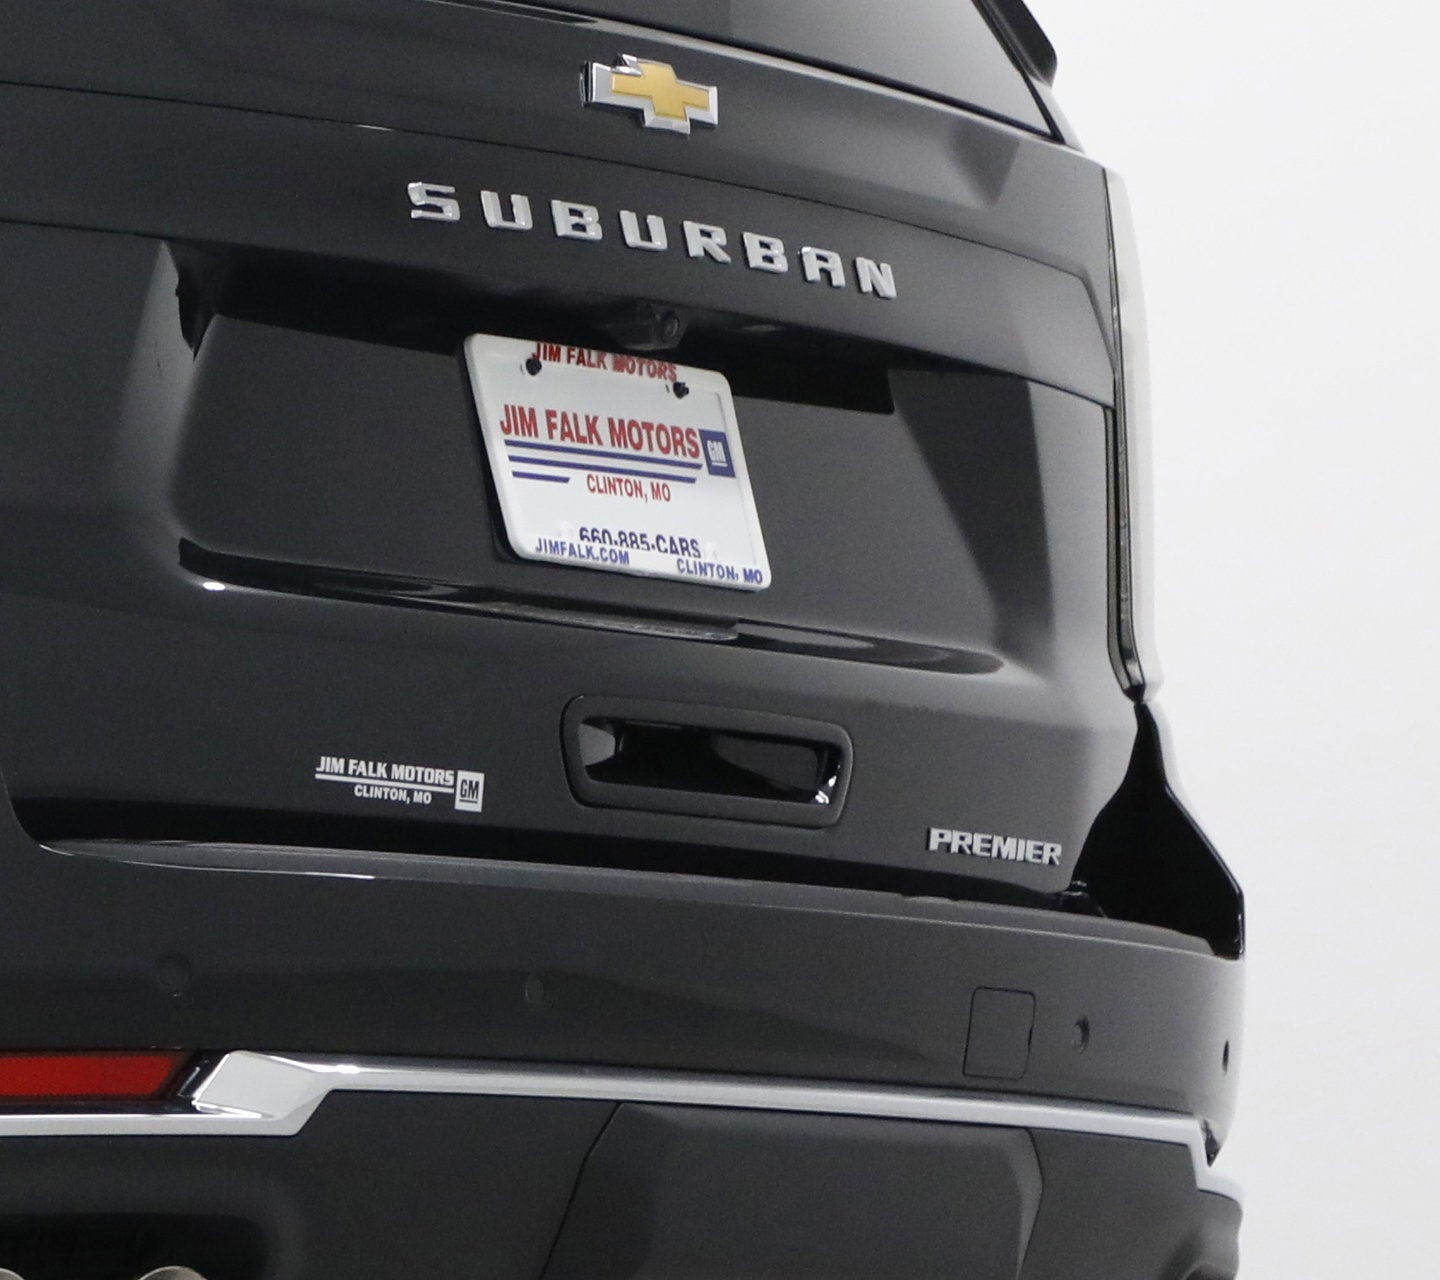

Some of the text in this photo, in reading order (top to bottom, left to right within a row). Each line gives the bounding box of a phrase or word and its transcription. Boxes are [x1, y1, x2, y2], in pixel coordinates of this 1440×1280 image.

[406, 181, 898, 300] SUBURBAN
[531, 342, 678, 383] JIM FALK MOTORS
[499, 403, 701, 460] JIM FALK MOTORS
[706, 438, 726, 463] GM
[586, 473, 672, 504] CLINTON, MO
[535, 537, 630, 566] JIMFALK.COM
[677, 558, 764, 584] CLINTON, MO
[315, 756, 455, 787] JIM FALK MOTORS
[353, 784, 433, 805] CLINTON, MO
[460, 778, 480, 800] GM
[928, 827, 1063, 866] PREMIER
